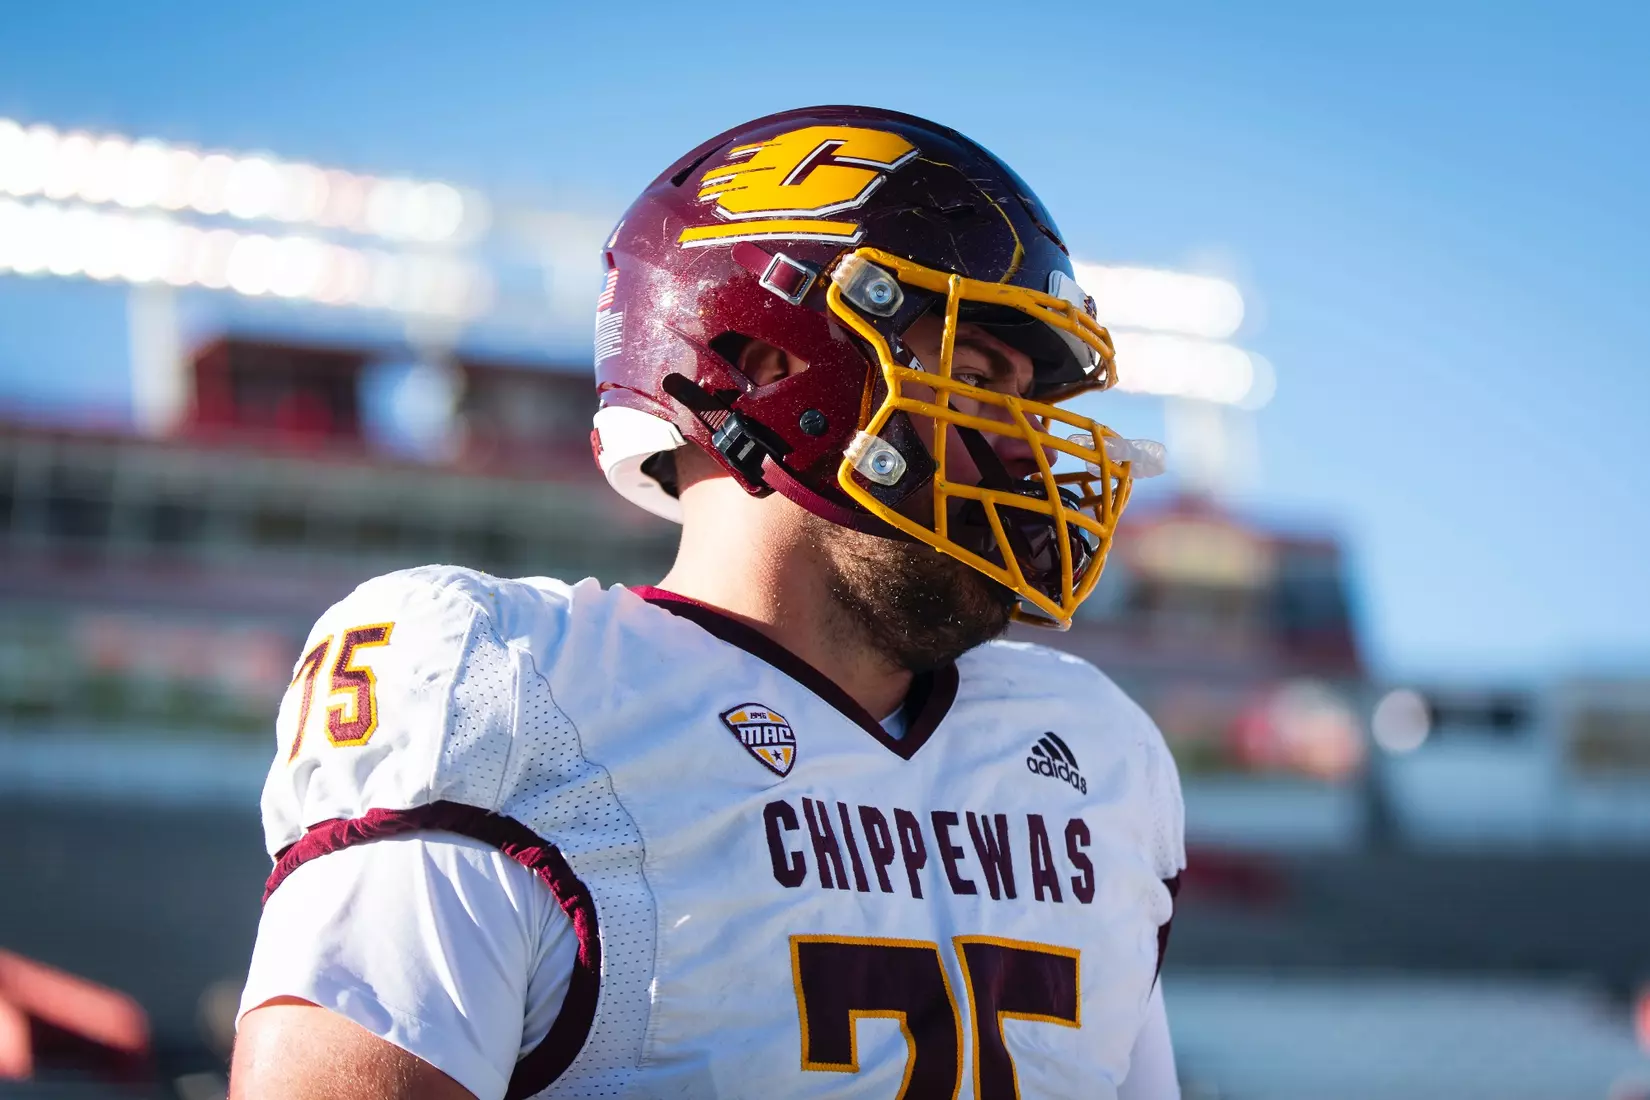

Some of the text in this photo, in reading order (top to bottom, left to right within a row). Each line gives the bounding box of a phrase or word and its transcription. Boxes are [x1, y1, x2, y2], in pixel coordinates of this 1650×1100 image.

[283, 622, 396, 764] 75
[738, 726, 796, 745] MAC
[1026, 756, 1087, 795] adidas
[763, 797, 1095, 904] CHIPPEWAS
